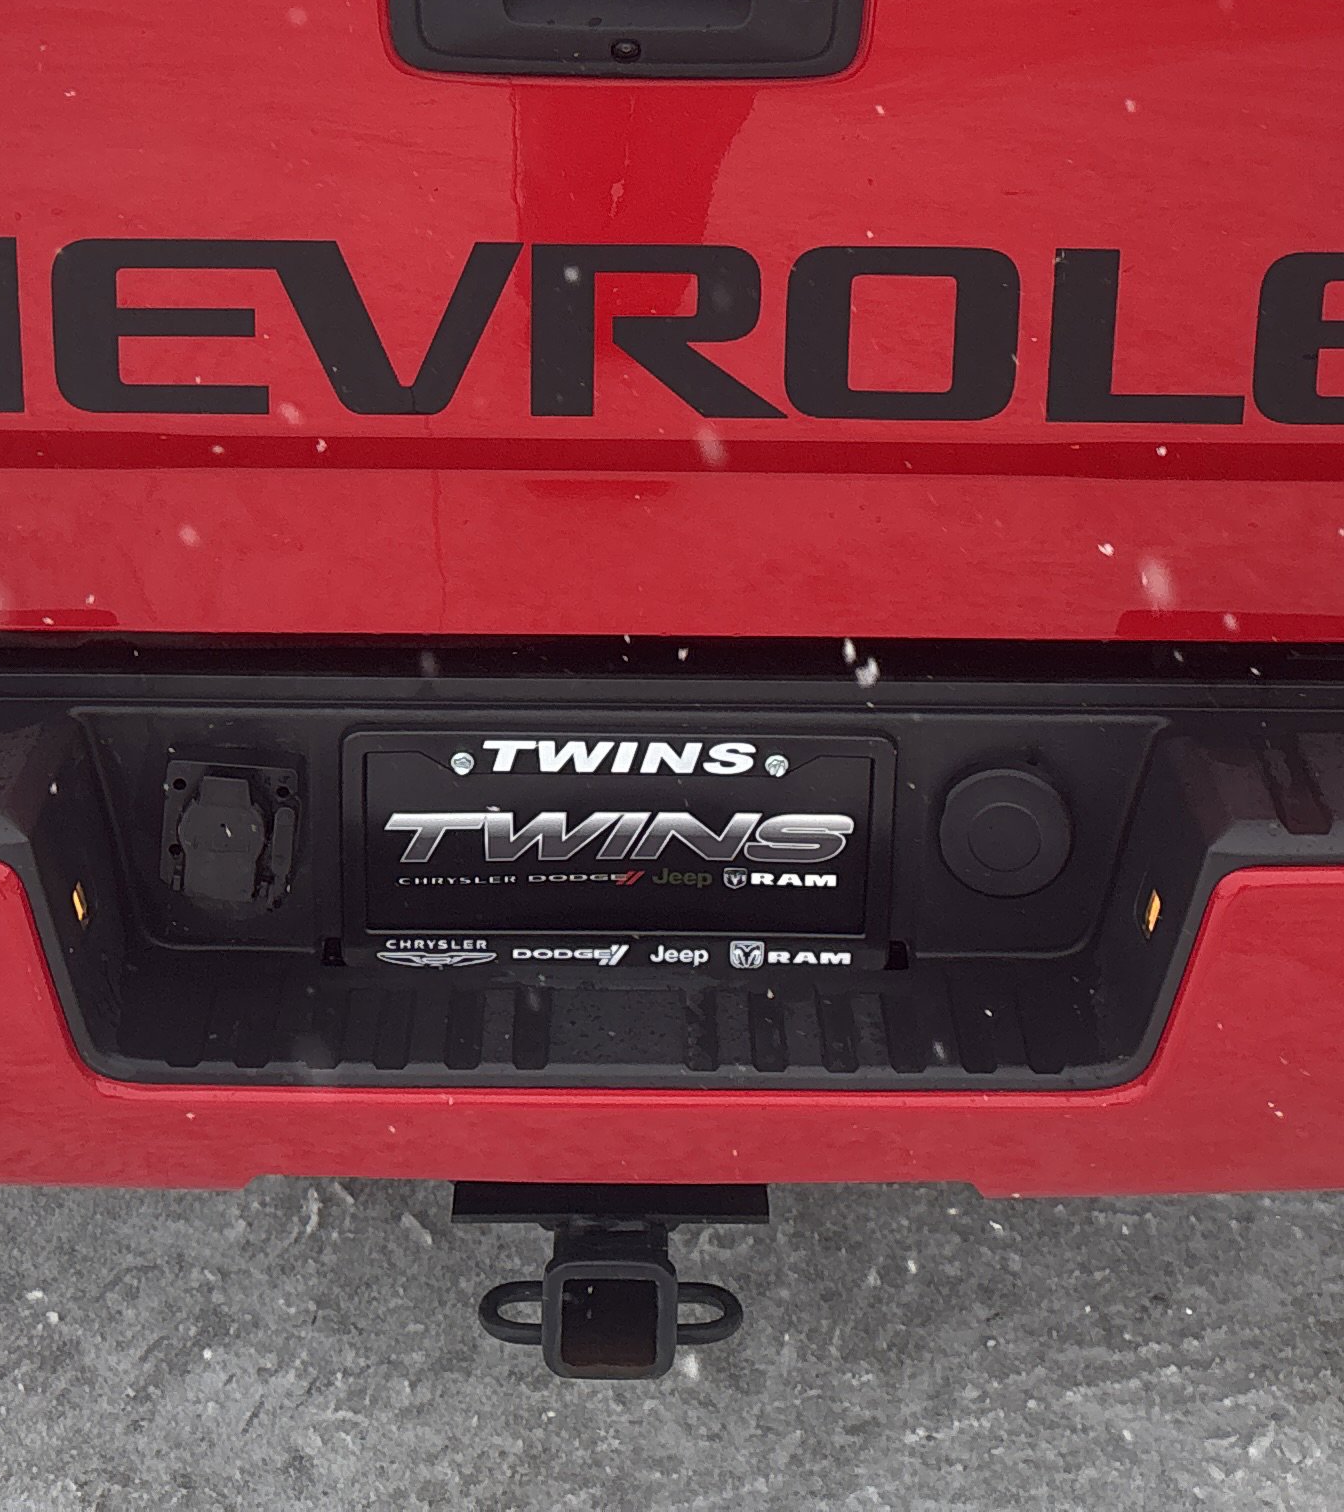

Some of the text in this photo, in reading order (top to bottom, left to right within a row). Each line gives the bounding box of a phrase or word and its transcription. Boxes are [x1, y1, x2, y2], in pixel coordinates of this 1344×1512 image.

[482, 740, 756, 775] TWINS
[384, 811, 855, 863] TWINS
[398, 868, 837, 888] CHRYSLER DODGE Jeep RAM
[385, 939, 852, 966] CHRYSLER DODGE Jeep RAM
